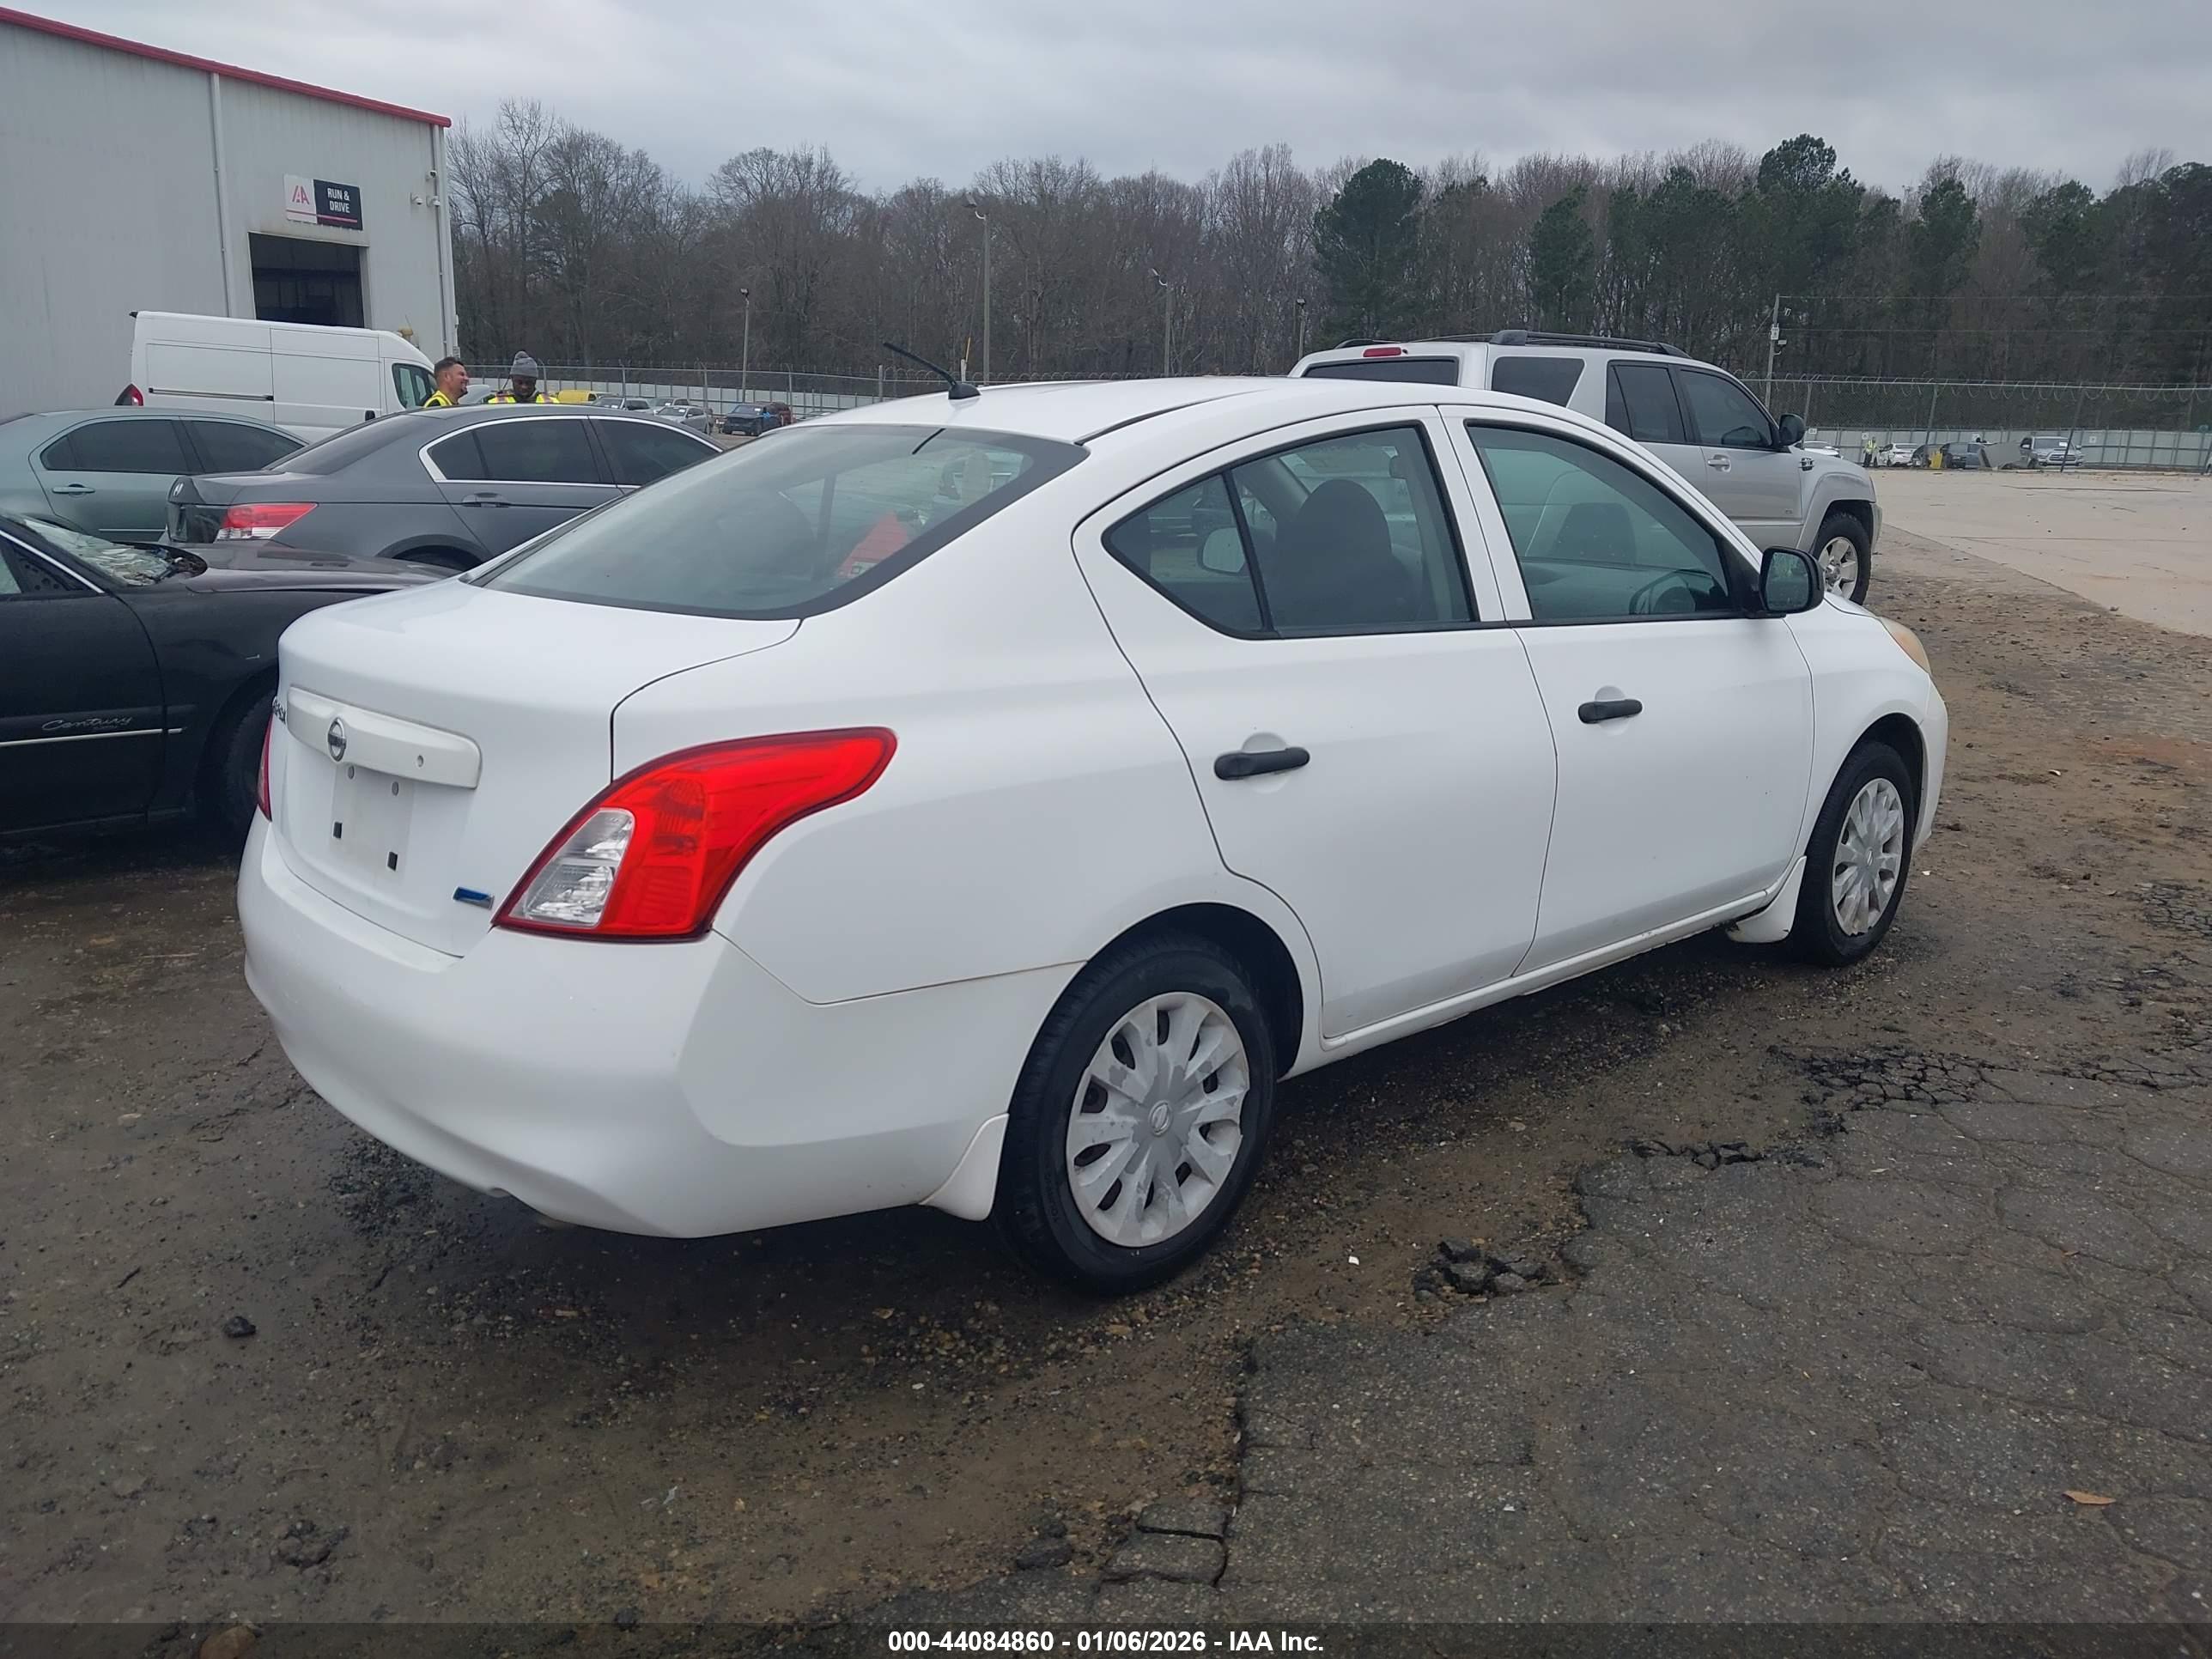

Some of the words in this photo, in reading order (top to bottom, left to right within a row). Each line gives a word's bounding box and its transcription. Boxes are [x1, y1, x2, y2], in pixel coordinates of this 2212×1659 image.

[327, 187, 343, 200] RUN
[343, 191, 350, 202] &
[329, 200, 350, 214] DRIVE
[42, 716, 132, 731] Century
